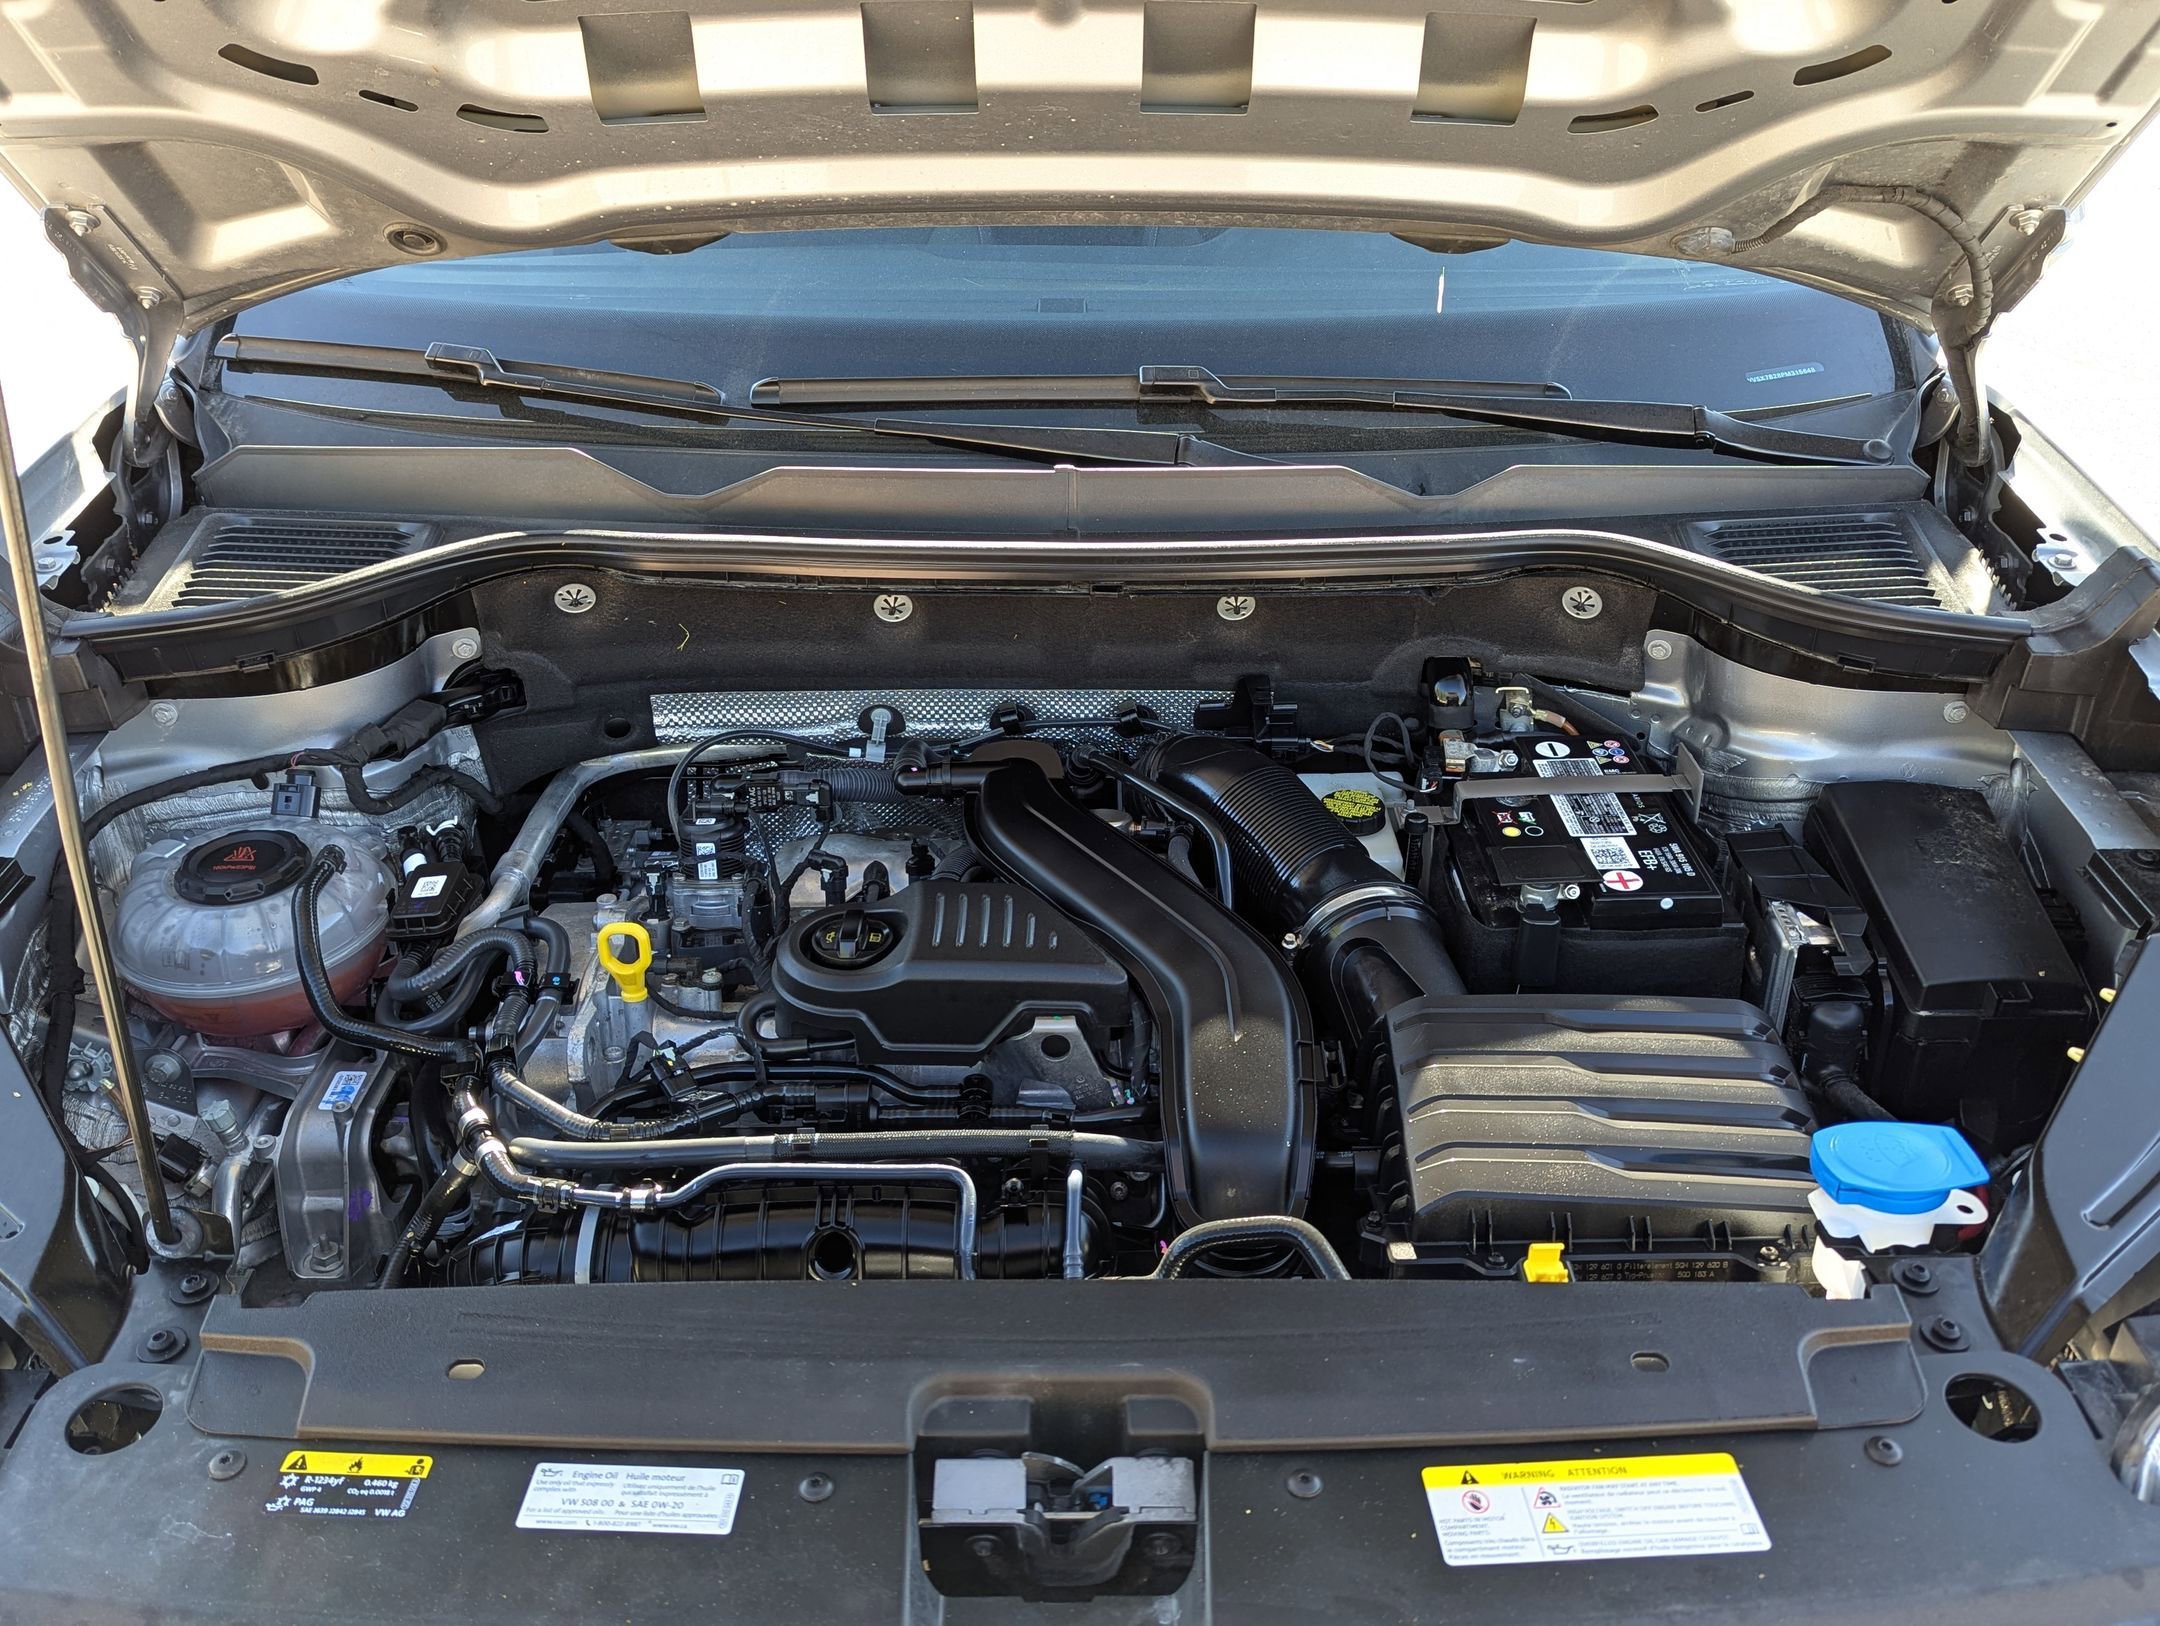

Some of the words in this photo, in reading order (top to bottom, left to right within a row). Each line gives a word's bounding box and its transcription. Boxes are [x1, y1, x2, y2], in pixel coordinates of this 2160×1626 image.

[1638, 850, 1658, 871] EFB+
[572, 1470, 603, 1480] Engine
[604, 1471, 619, 1479] Oil
[625, 1472, 650, 1481] Huile
[651, 1473, 686, 1482] moteur
[1502, 1469, 1555, 1480] WARNING
[1567, 1465, 1628, 1477] ATTENTION
[304, 1475, 345, 1487] R-1234yf
[293, 1497, 315, 1507] PAG
[560, 1497, 579, 1506] VW
[580, 1498, 599, 1507] 508
[600, 1499, 615, 1507] 00
[630, 1500, 649, 1508] SAE
[650, 1501, 685, 1510] 0W-20
[374, 1508, 391, 1517] VW
[390, 1509, 406, 1518] AG
